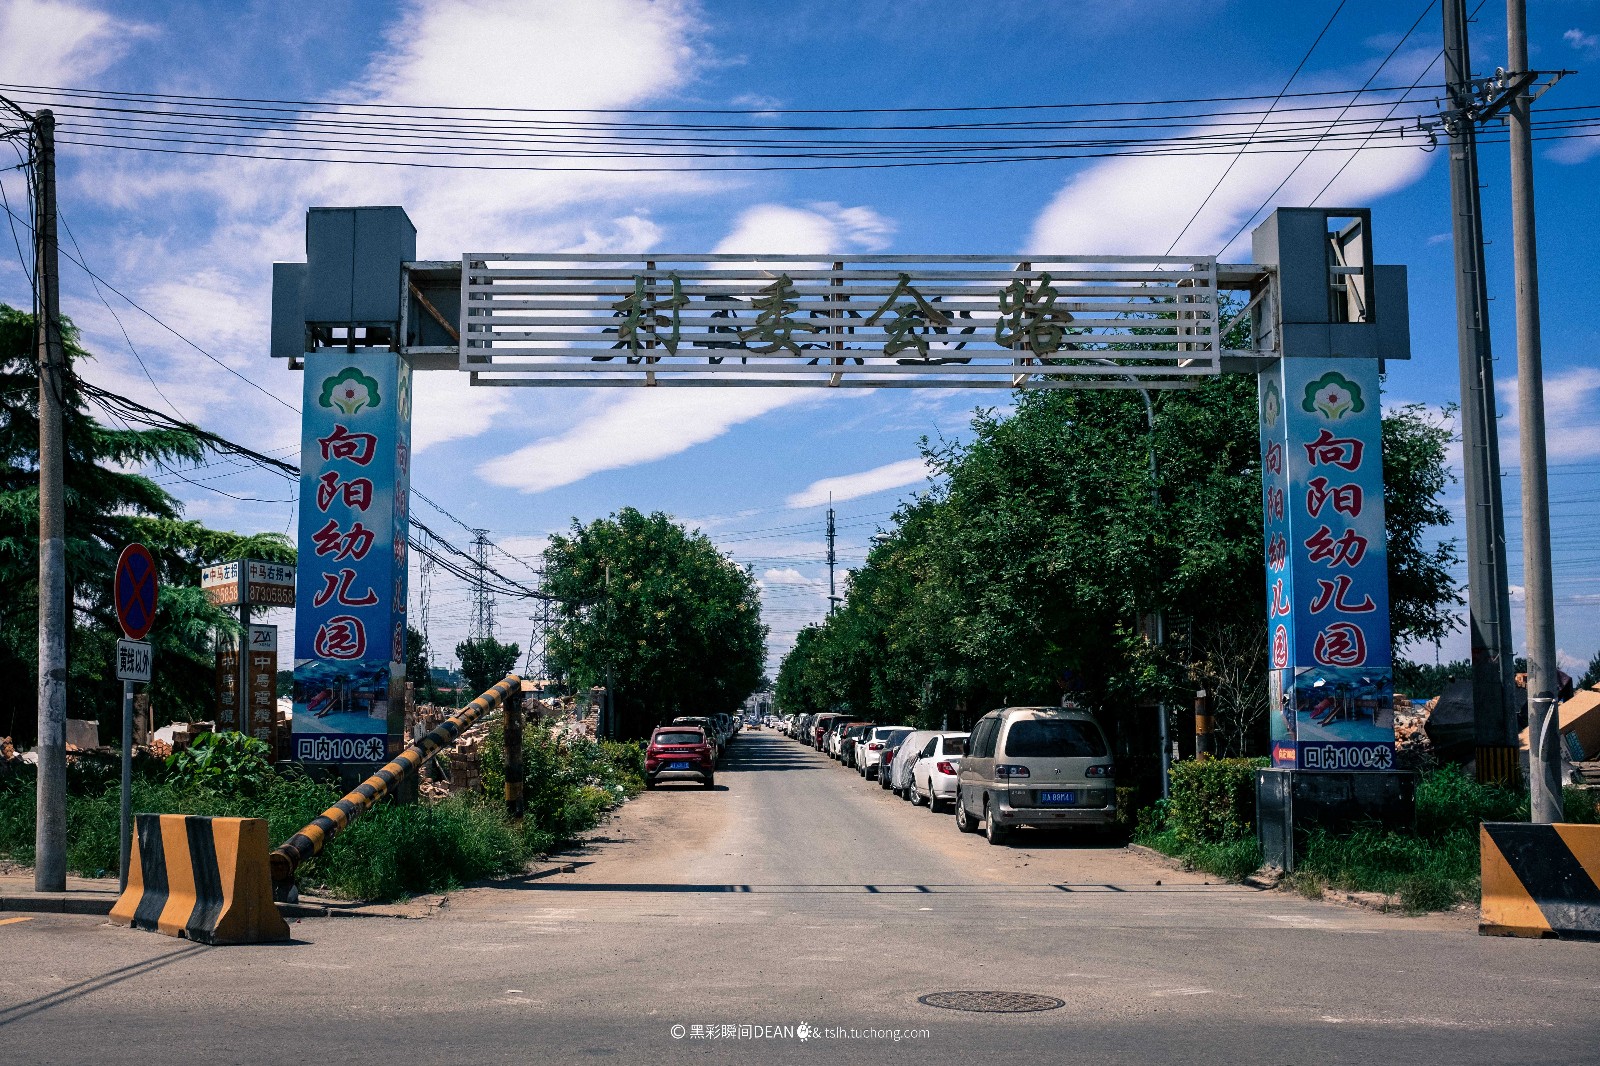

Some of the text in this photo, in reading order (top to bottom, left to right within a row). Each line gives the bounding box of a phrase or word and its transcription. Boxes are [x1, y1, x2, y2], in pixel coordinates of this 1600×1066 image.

[611, 271, 1073, 357] 村委会路
[312, 423, 378, 660] 向阳幼儿园
[392, 432, 407, 665] 向阳幼儿园
[1265, 438, 1290, 668] 向阳幼儿园
[1303, 429, 1377, 668] 向阳幼儿园
[209, 563, 238, 582] 中马左拐
[249, 585, 294, 604] 87305858
[250, 563, 284, 581] 中马右拐
[120, 646, 149, 675] 黄线以外
[1304, 744, 1393, 769] 口内100米
